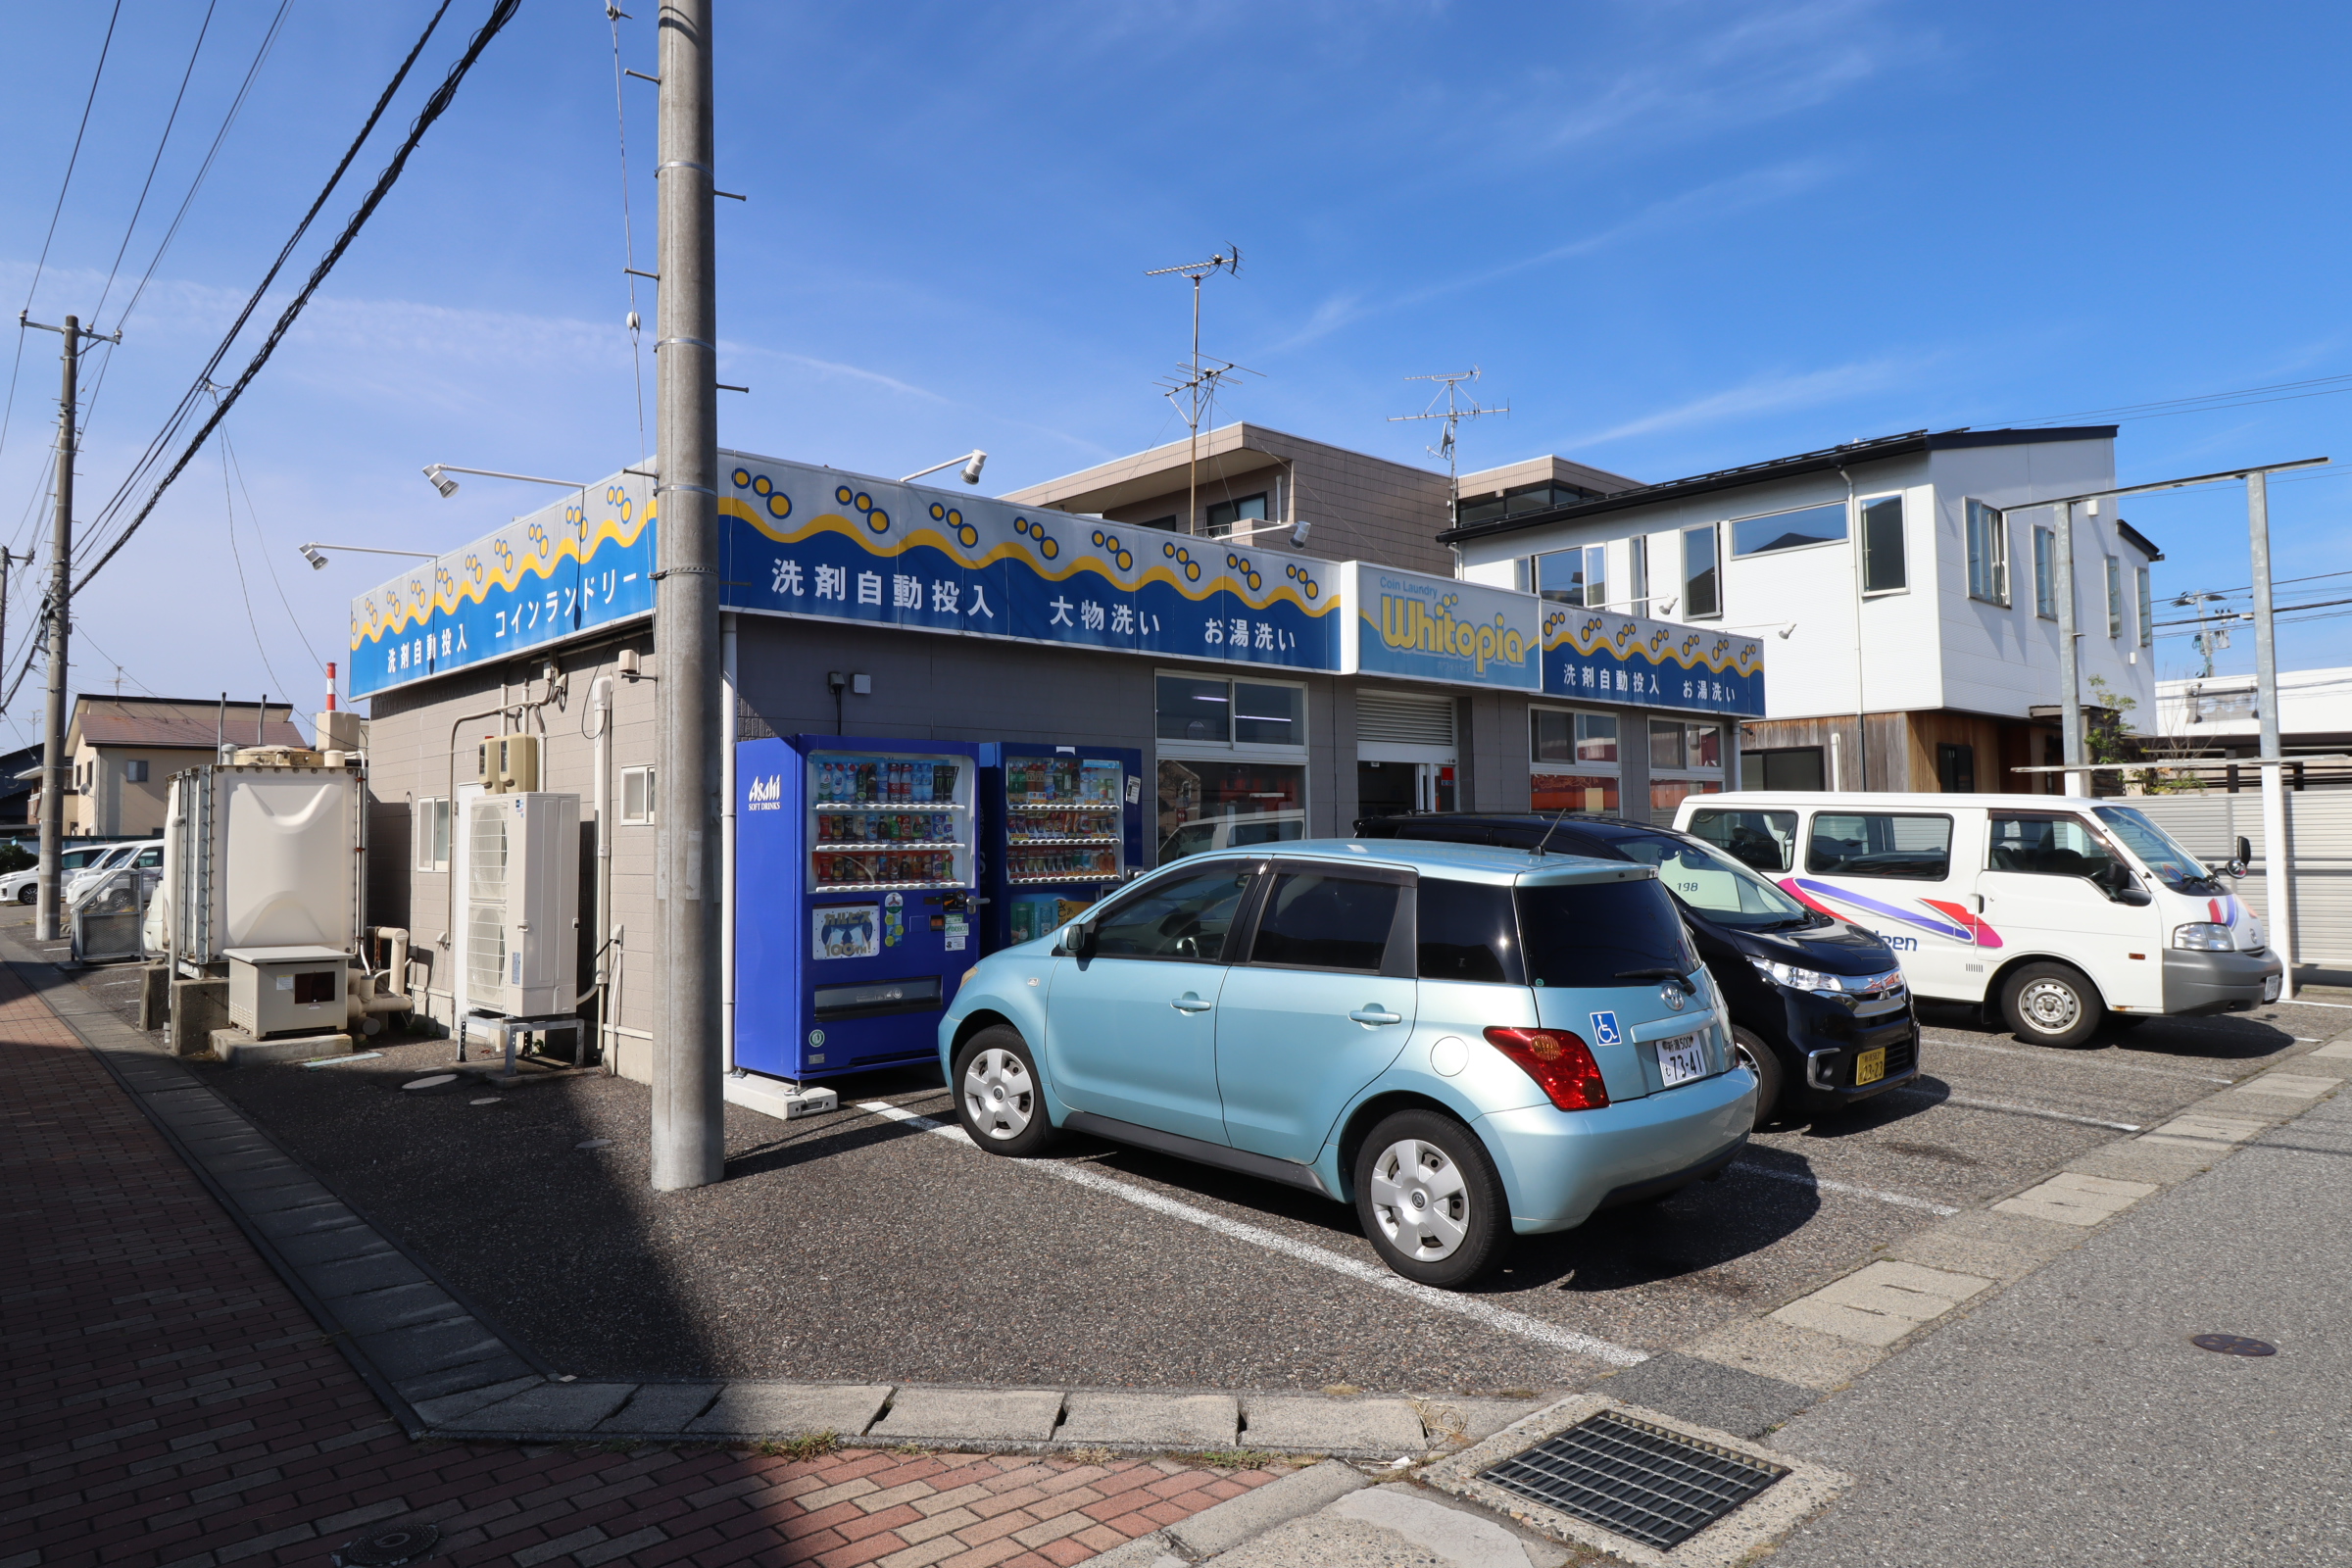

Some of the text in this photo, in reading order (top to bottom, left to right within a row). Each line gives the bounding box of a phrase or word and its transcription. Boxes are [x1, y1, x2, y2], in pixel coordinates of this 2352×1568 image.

[1380, 576, 1438, 599] Coin Laundry
[771, 558, 1297, 651] 洗剤自動投入 大物洗い お湯洗い
[387, 569, 637, 673] 洗剤自動投入 コインランドリー
[1380, 592, 1525, 675] Whitopia
[1563, 663, 1736, 703] 洗剤自動投入 お湯洗い
[749, 774, 780, 802] Asahi
[761, 802, 780, 810] DRINKS
[1677, 882, 1698, 892] 198
[824, 910, 871, 925] カルピス
